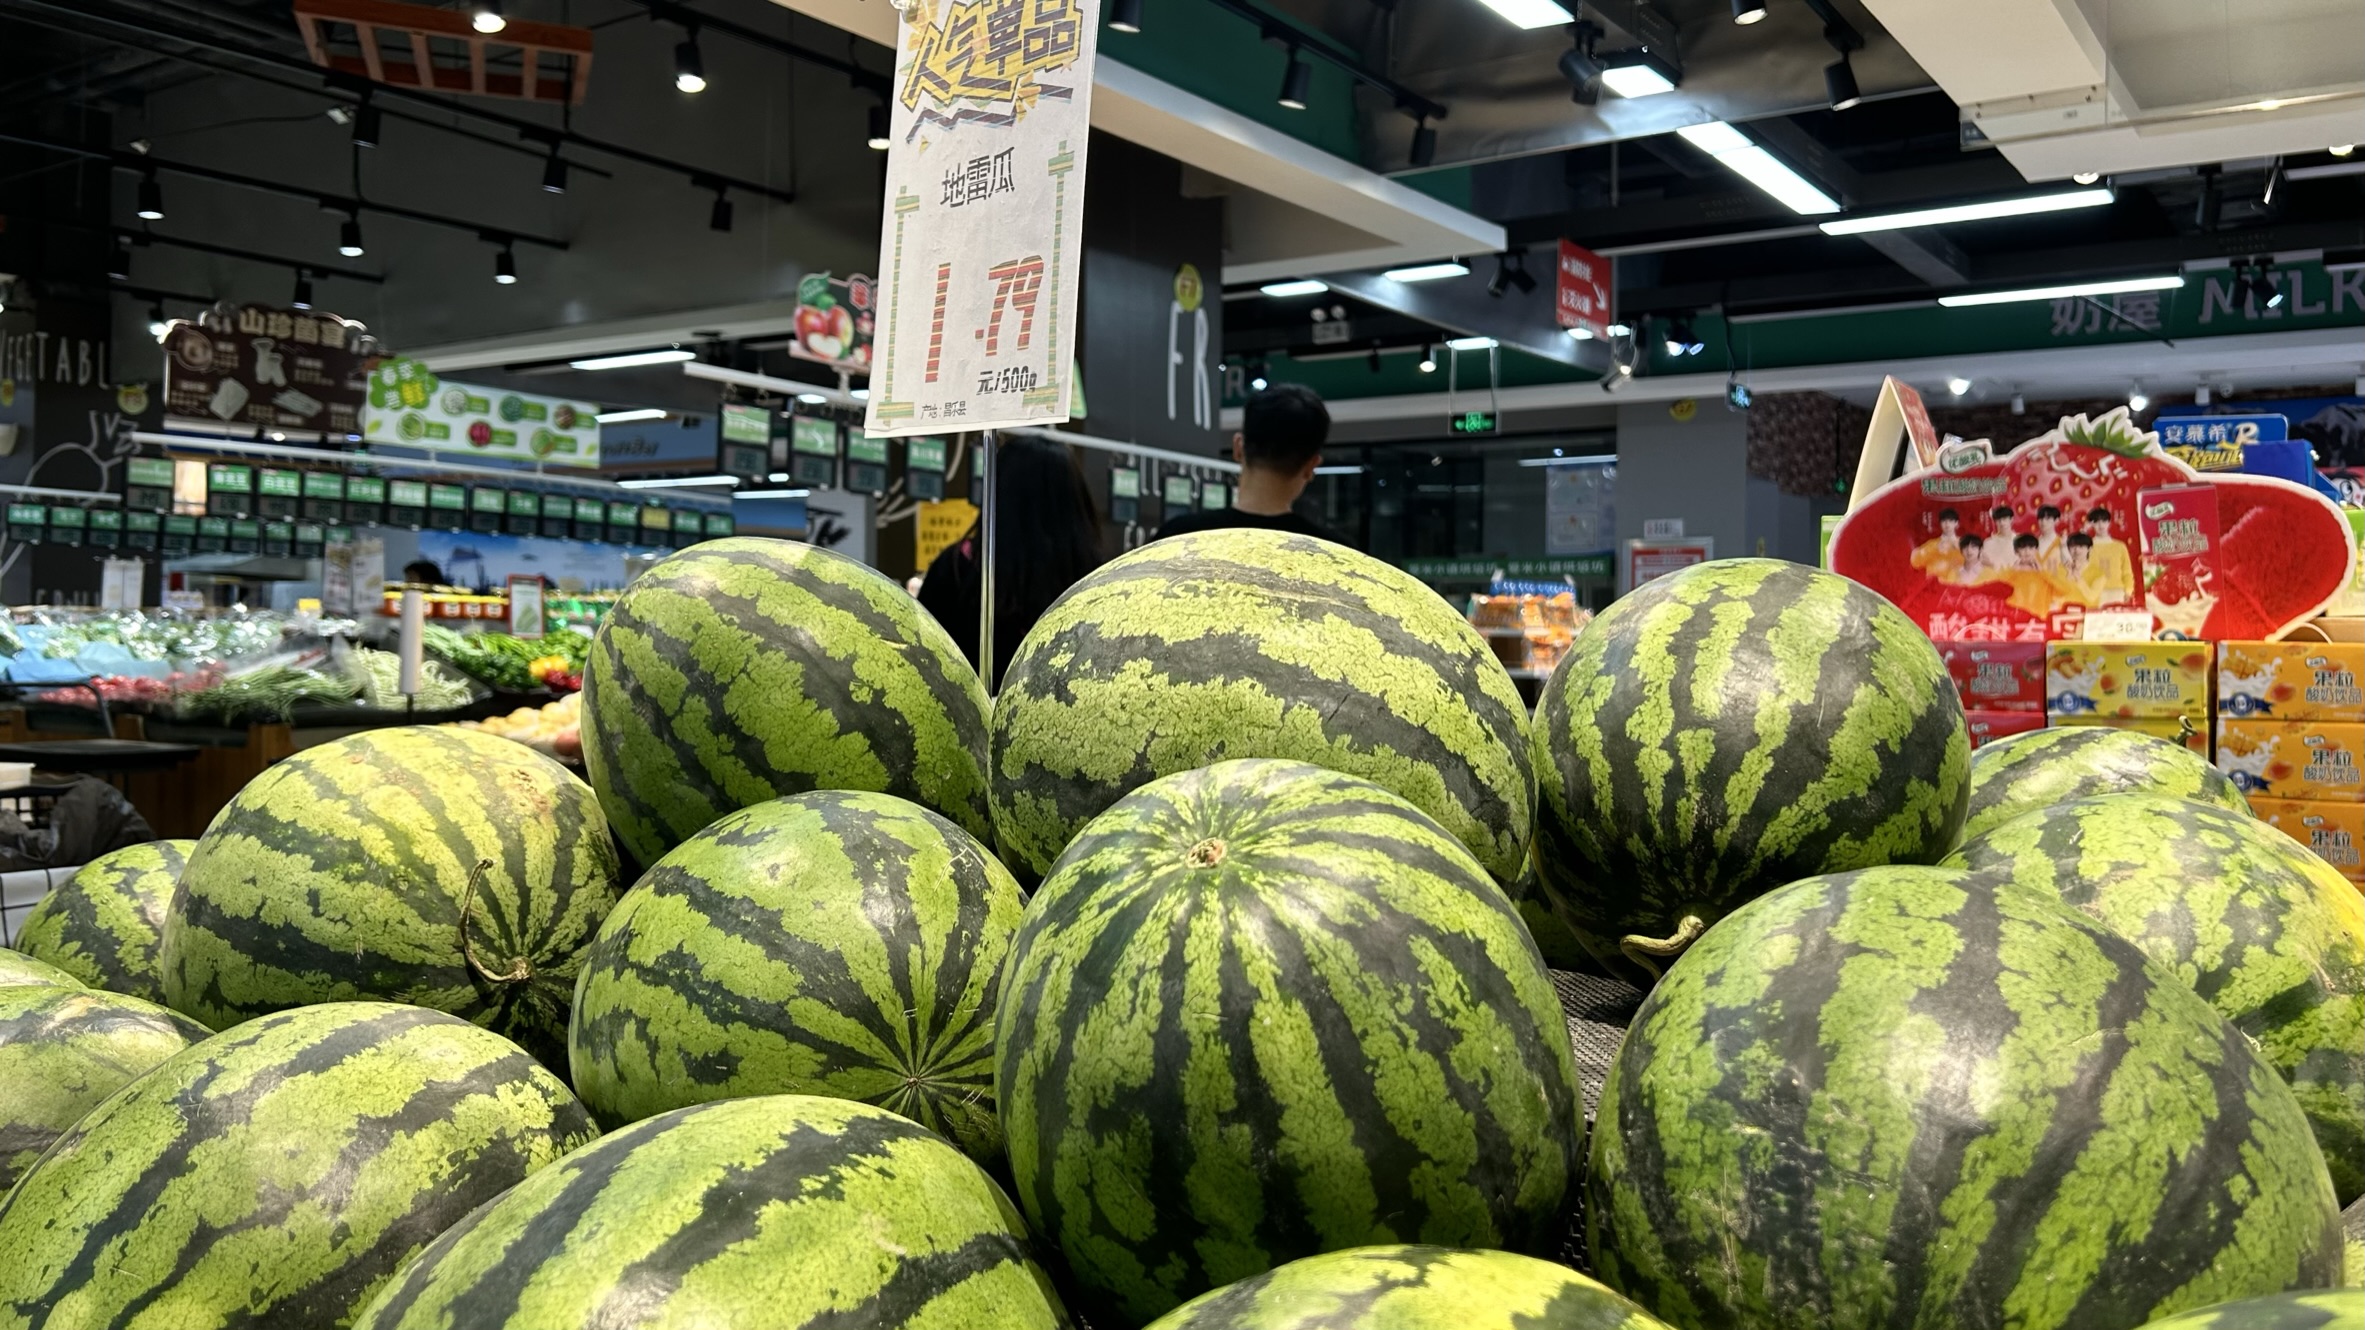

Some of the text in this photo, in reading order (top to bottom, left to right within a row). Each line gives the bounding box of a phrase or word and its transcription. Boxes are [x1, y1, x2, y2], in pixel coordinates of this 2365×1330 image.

[939, 146, 1016, 208] 地雷瓜
[2198, 266, 2365, 323] MILK
[924, 254, 1045, 384] 1.79
[976, 365, 1038, 396] 元/500g
[2164, 423, 2227, 446] 安慕希
[2159, 518, 2199, 537] 果粒
[2152, 534, 2208, 555] 酸奶饮品
[1977, 662, 2013, 679] 果粒
[2133, 668, 2172, 684] 果粒
[2314, 670, 2354, 687] 果粒
[2126, 684, 2180, 701] 酸奶饮品
[2305, 687, 2362, 705] 酸奶饮品
[2312, 749, 2352, 766] 果粒
[2303, 766, 2361, 784] 酸奶饮品
[2311, 829, 2351, 847] 果粒
[2309, 846, 2361, 865] 奶饮品
